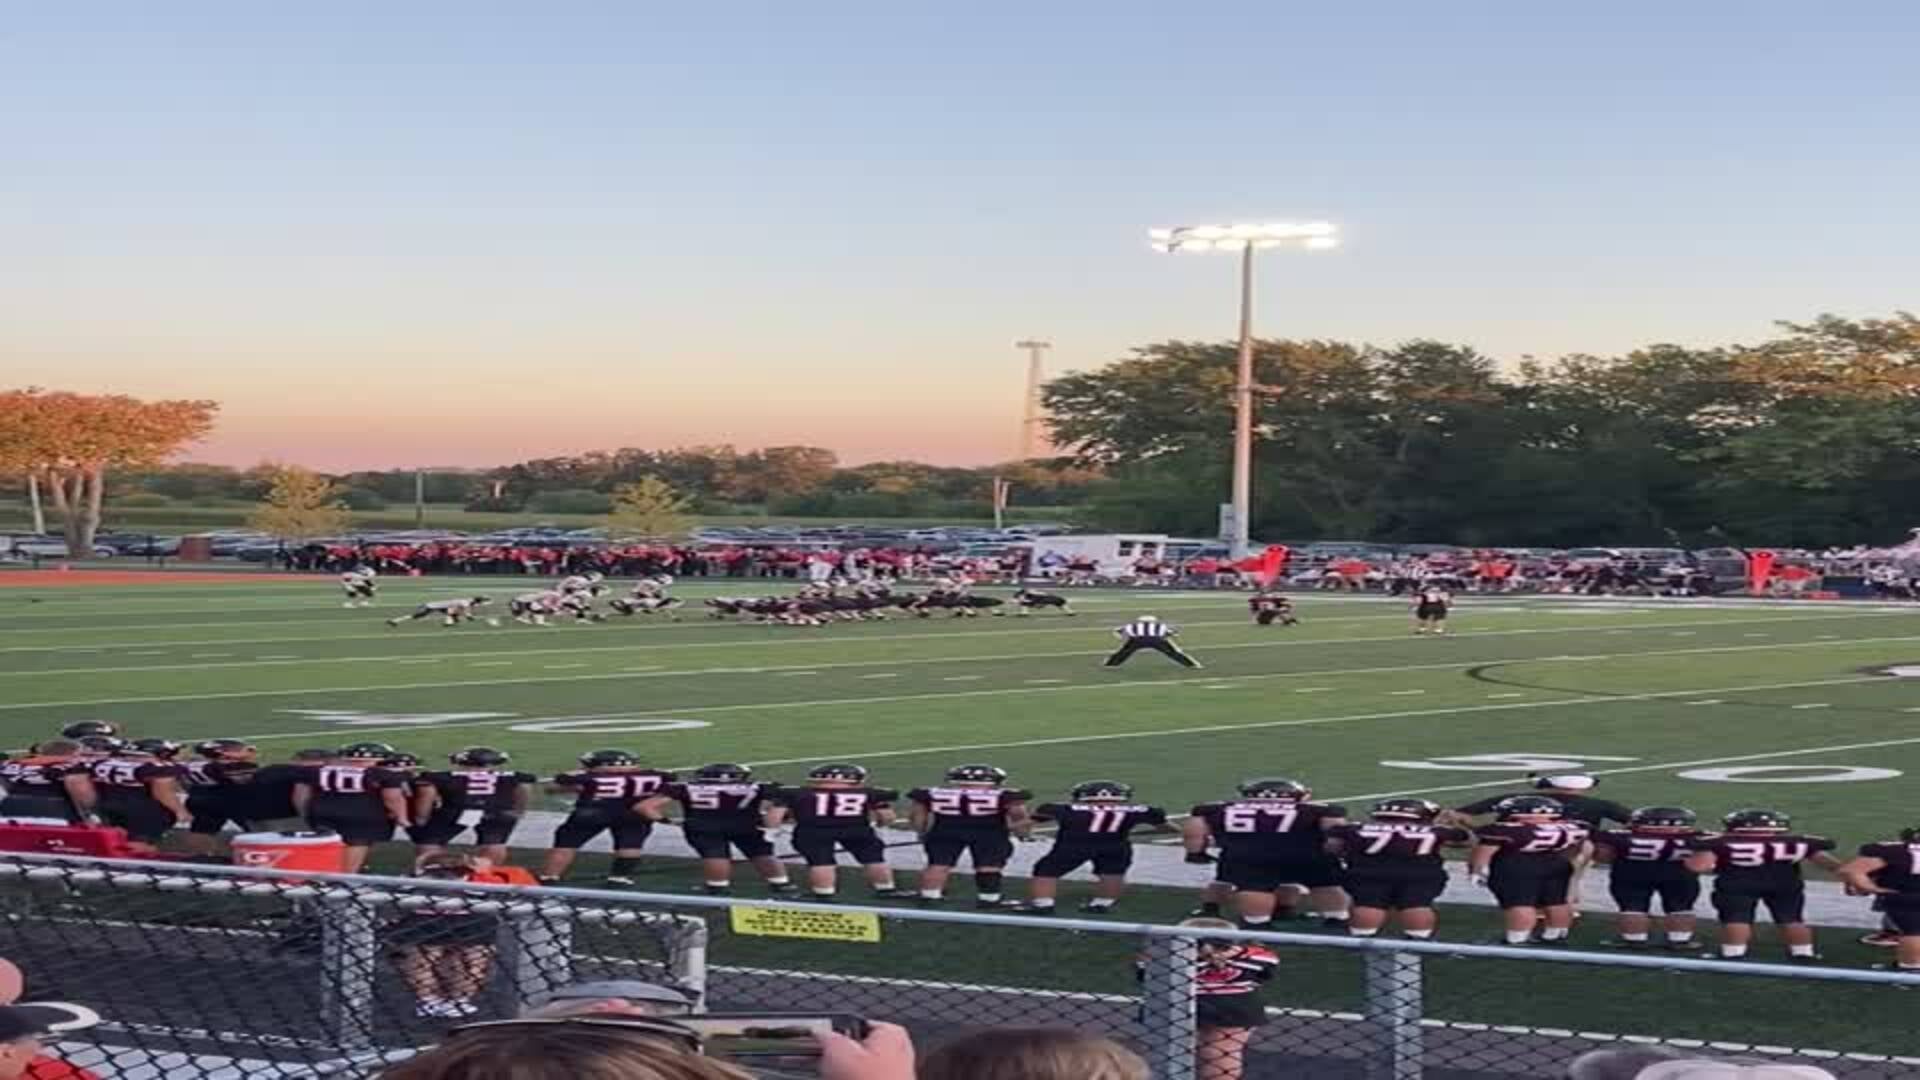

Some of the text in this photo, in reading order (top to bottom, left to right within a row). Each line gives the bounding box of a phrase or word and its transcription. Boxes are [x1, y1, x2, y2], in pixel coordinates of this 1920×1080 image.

[688, 788, 759, 809] 57
[814, 793, 868, 816] 18
[931, 794, 999, 816] 22
[1224, 808, 1298, 833] 67
[1356, 830, 1438, 855] 77
[243, 851, 270, 864] G
[1729, 843, 1808, 866] 34
